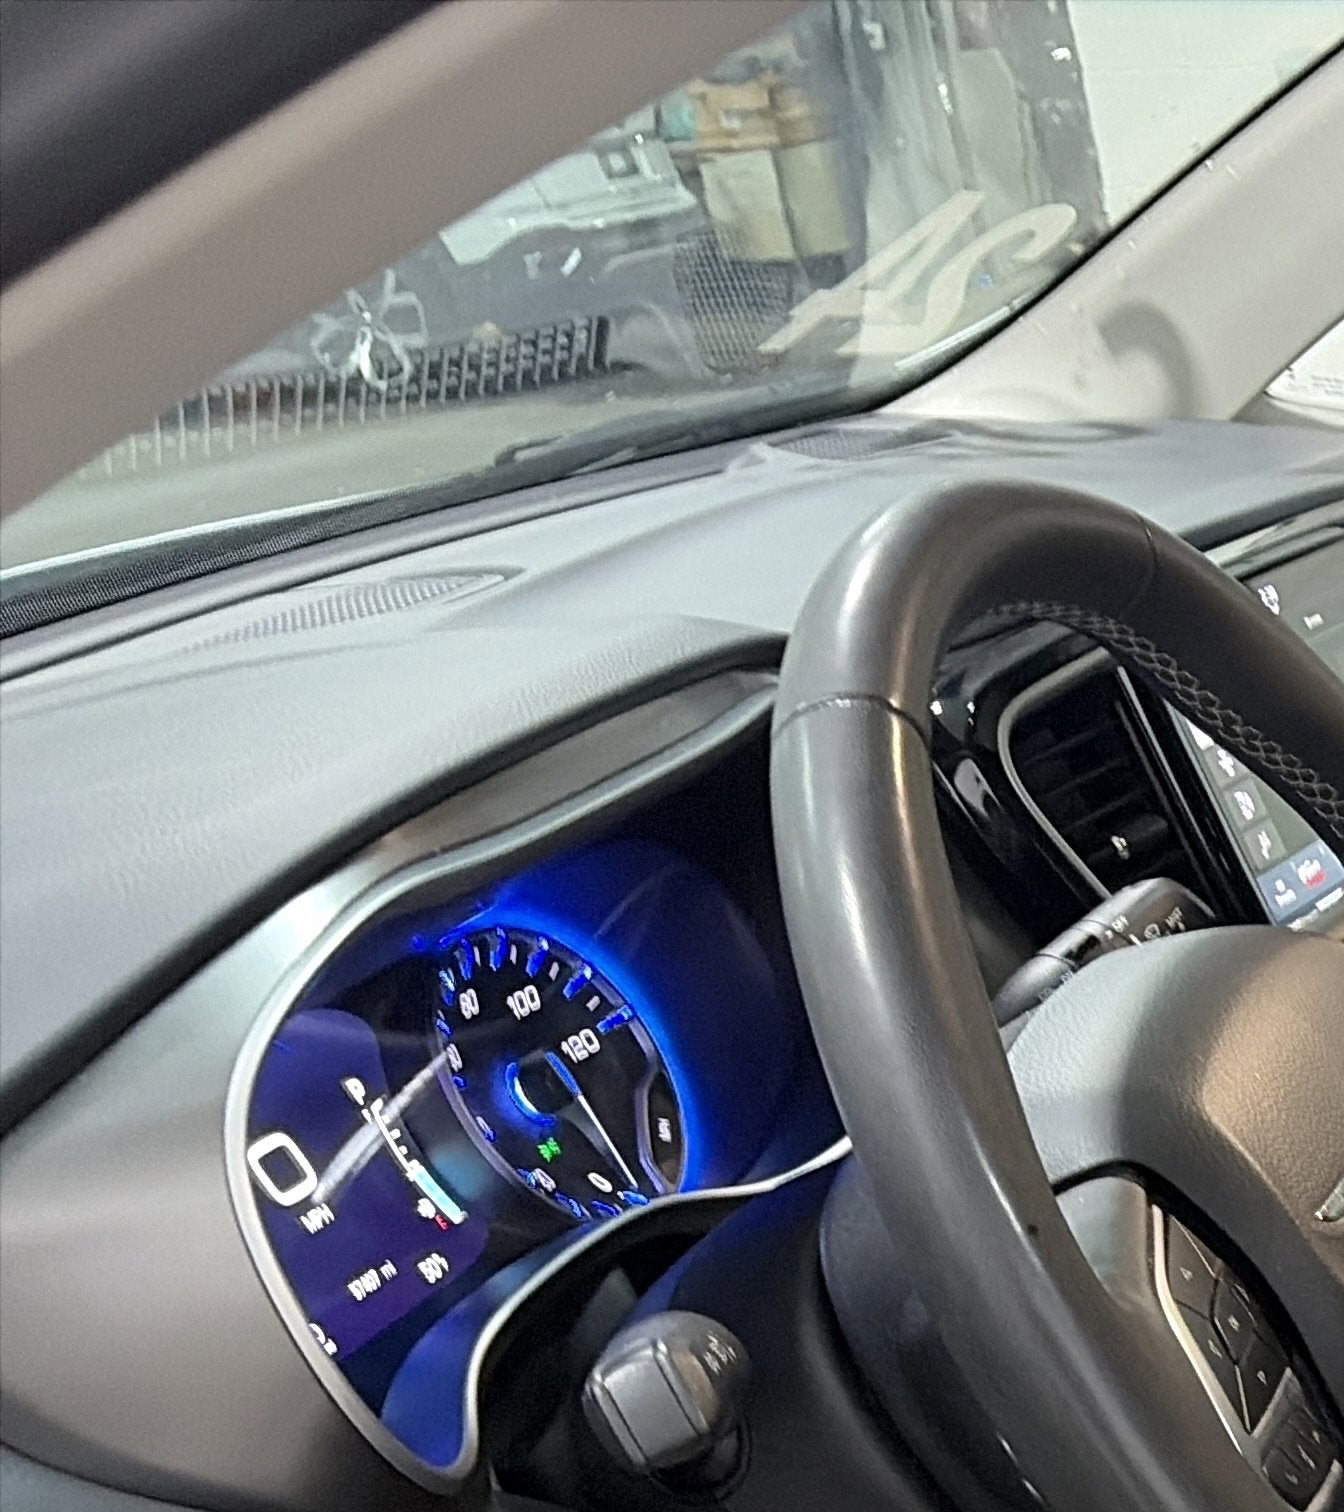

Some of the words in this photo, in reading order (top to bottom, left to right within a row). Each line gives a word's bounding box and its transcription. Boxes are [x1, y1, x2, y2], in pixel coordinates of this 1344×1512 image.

[507, 985, 541, 1020] 100
[561, 1028, 600, 1063] 120
[247, 1132, 318, 1207] 0
[587, 1172, 613, 1193] 0
[300, 1203, 335, 1234] MPH
